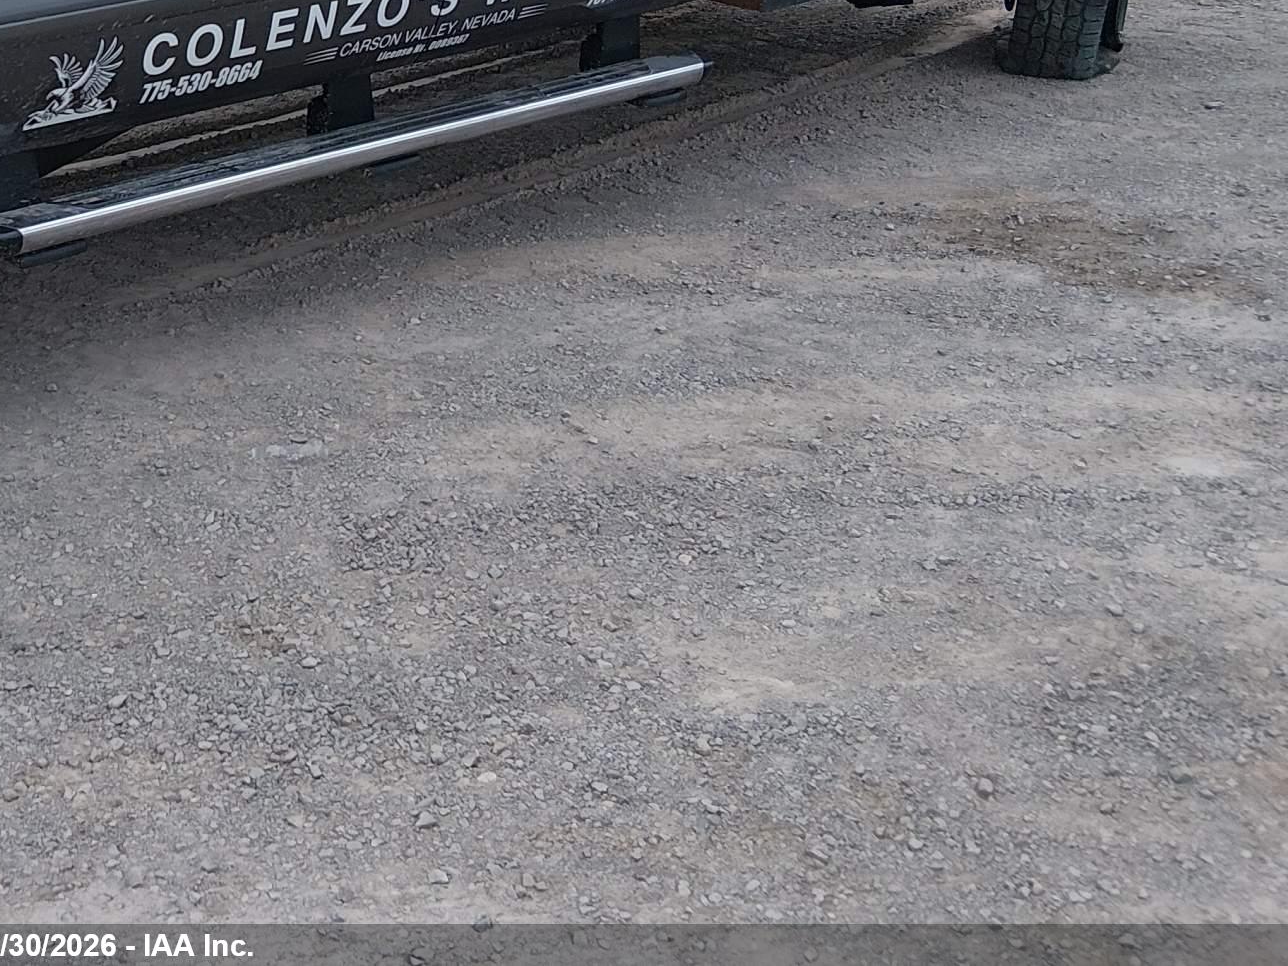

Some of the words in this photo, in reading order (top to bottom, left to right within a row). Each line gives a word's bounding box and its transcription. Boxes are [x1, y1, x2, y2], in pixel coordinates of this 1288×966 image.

[339, 33, 402, 57] CARSON
[405, 20, 458, 42] VALLEY,
[461, 8, 515, 32] NEVADA
[139, 60, 262, 104] 775-530-8664
